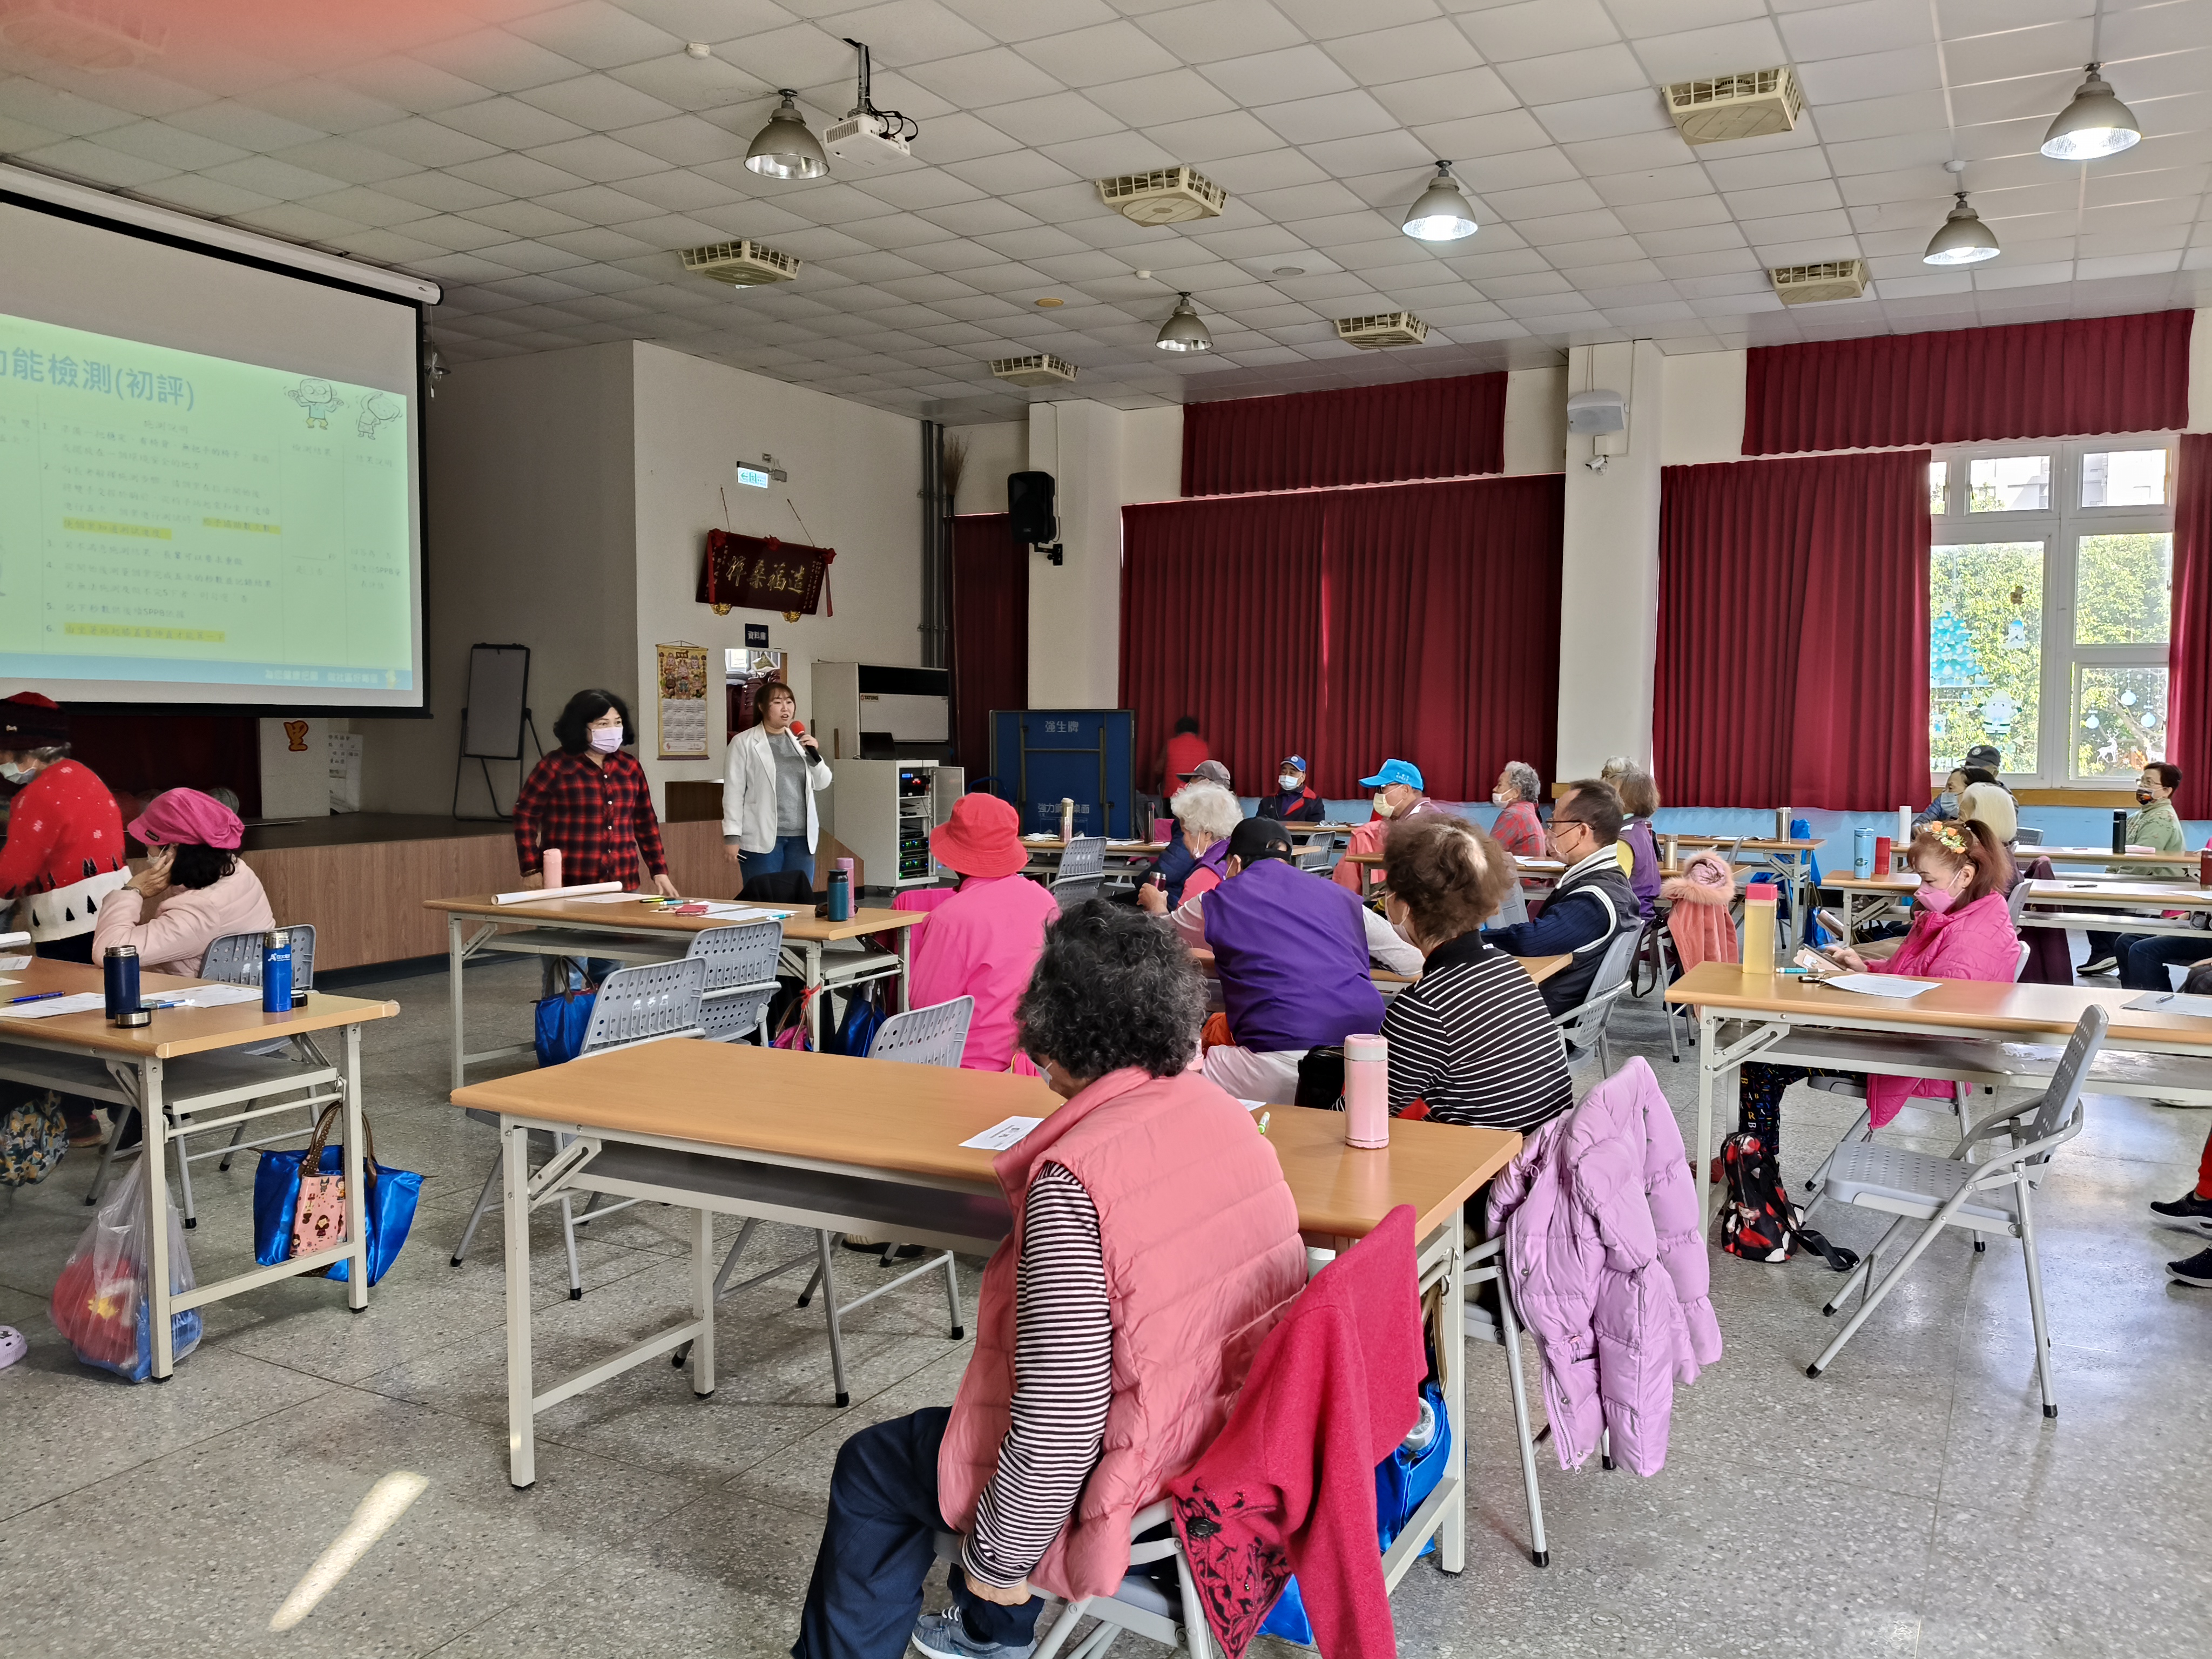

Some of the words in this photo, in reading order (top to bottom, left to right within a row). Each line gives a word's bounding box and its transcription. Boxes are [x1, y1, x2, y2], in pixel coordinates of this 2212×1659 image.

[0, 346, 195, 412] 能檢測(初評)
[1045, 720, 1079, 733] 強生牌
